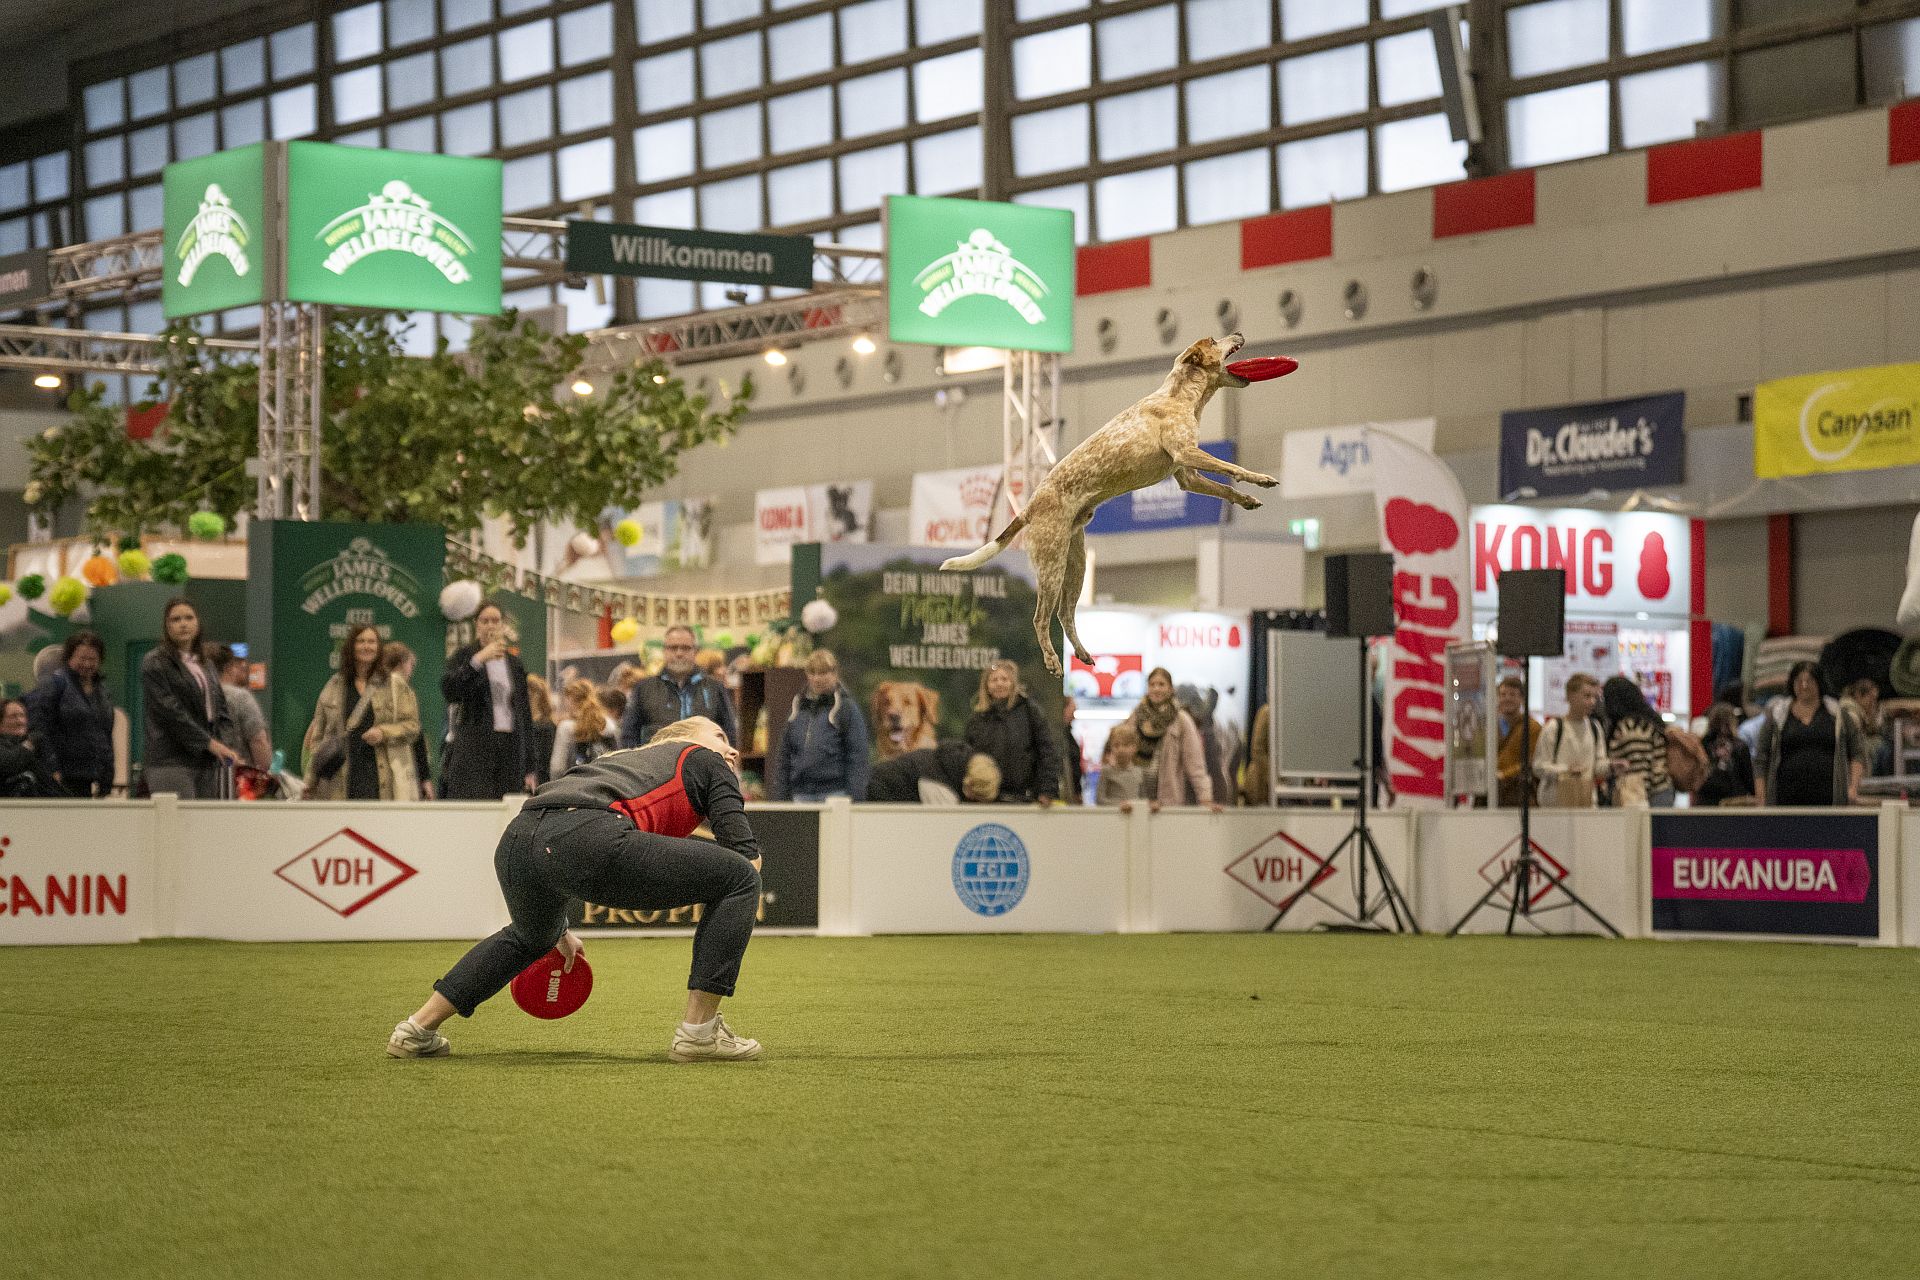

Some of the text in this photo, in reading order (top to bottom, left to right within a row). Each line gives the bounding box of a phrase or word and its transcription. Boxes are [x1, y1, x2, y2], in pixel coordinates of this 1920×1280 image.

[195, 211, 232, 236] JAMES
[362, 209, 434, 237] JAMES
[322, 229, 469, 284] WELLBELOVED
[610, 233, 774, 275] Willkommen
[951, 254, 1014, 283] JAMES
[918, 272, 1045, 325] WELLBELOVED
[1818, 408, 1912, 437] Canosan
[1555, 416, 1655, 463] Clauder's
[333, 561, 391, 582] JAMES
[1474, 522, 1614, 598] KONG
[301, 577, 419, 619] WELLBELOVED
[882, 571, 918, 595] DEIN
[972, 574, 1008, 598] WILL
[921, 622, 970, 646] JAMES
[1159, 624, 1222, 648] KONG
[1391, 571, 1461, 796] KONG
[311, 857, 374, 886] VDH
[977, 862, 1007, 878] FCI
[1252, 857, 1303, 883] VDH
[1672, 856, 1839, 892] EUKANUBA
[0, 873, 127, 917] ANIN
[545, 976, 561, 1003] KONG
